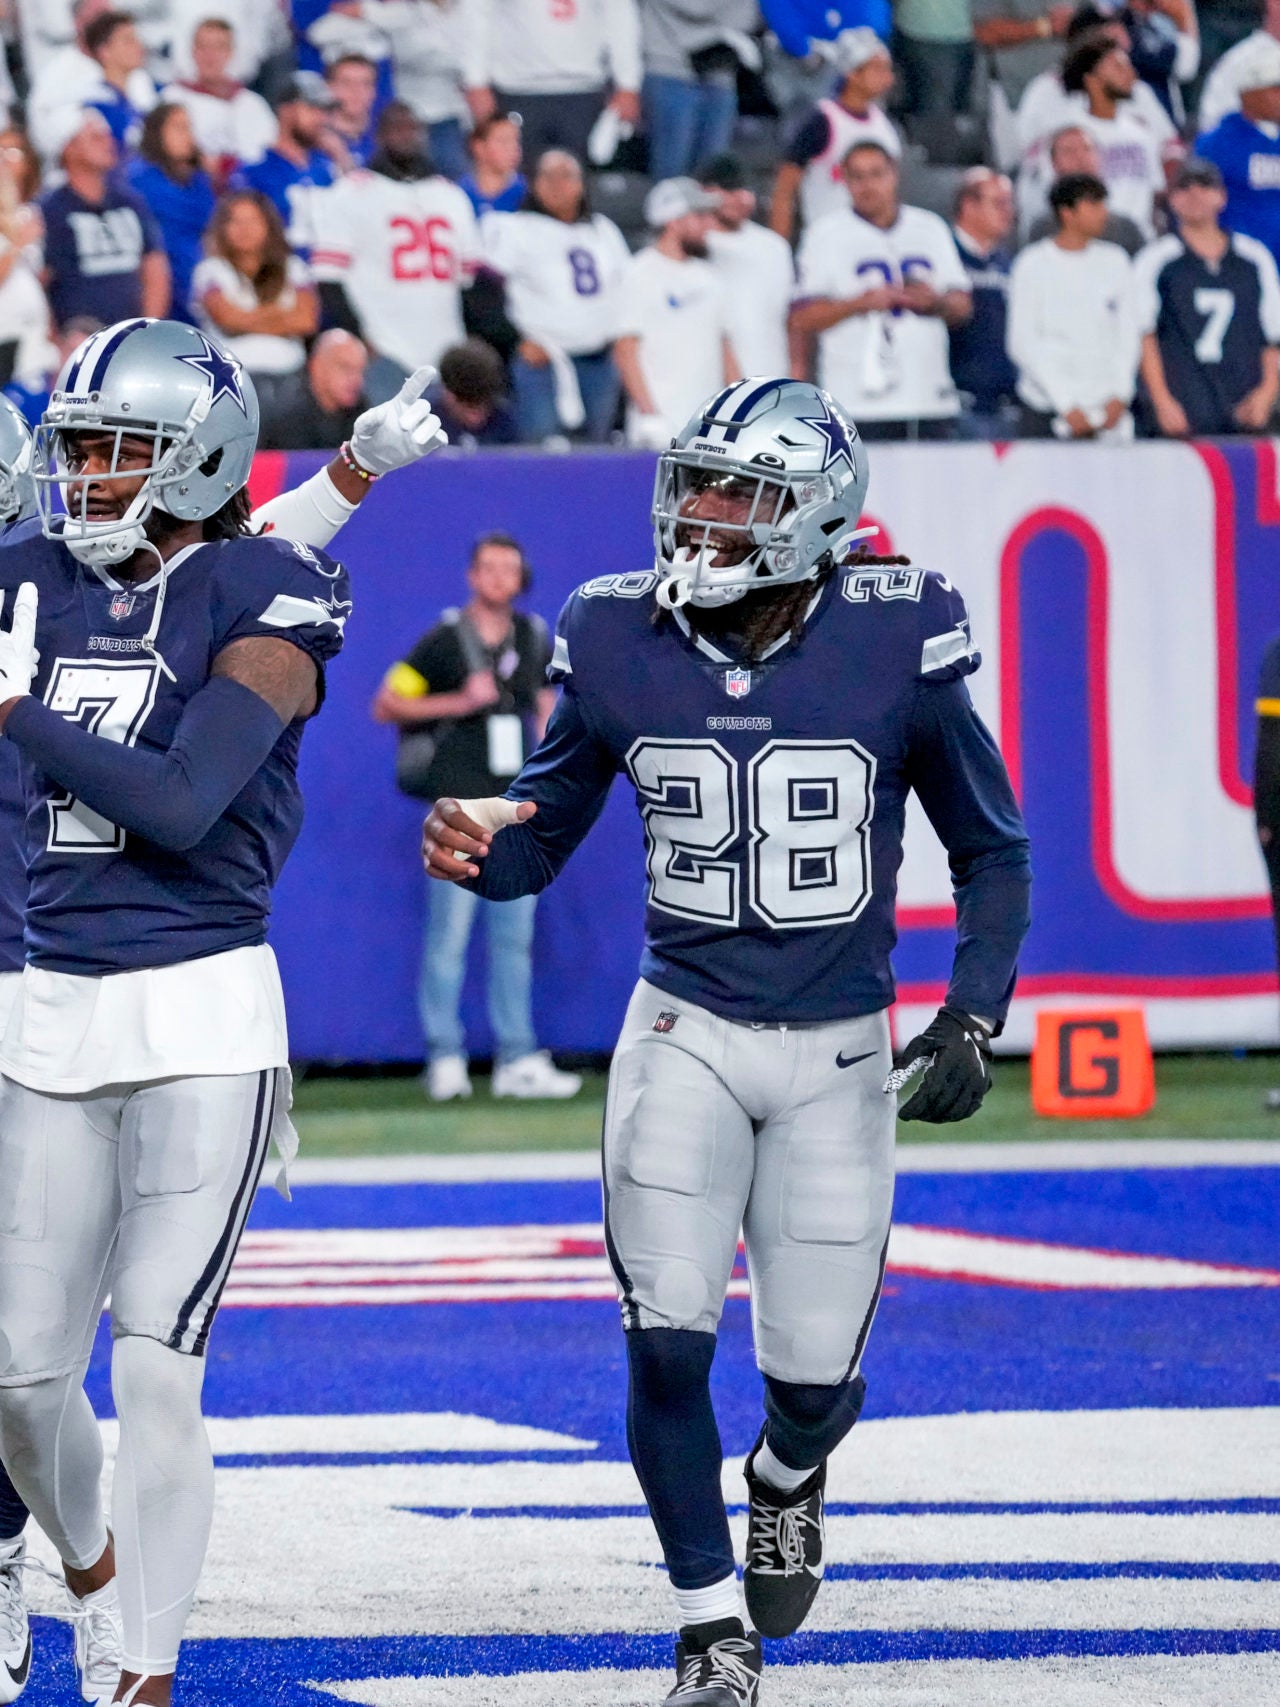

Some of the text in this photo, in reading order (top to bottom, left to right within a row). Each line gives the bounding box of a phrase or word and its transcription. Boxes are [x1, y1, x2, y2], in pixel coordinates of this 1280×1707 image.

[389, 215, 451, 281] 26
[567, 247, 601, 297] 8
[1194, 287, 1235, 364] 7
[65, 397, 88, 405] COWBOY
[694, 443, 727, 455] COWBOYS
[42, 657, 159, 853] 7
[706, 716, 772, 731] COWBOYS
[625, 737, 878, 929] 28
[1059, 1021, 1120, 1098] G
